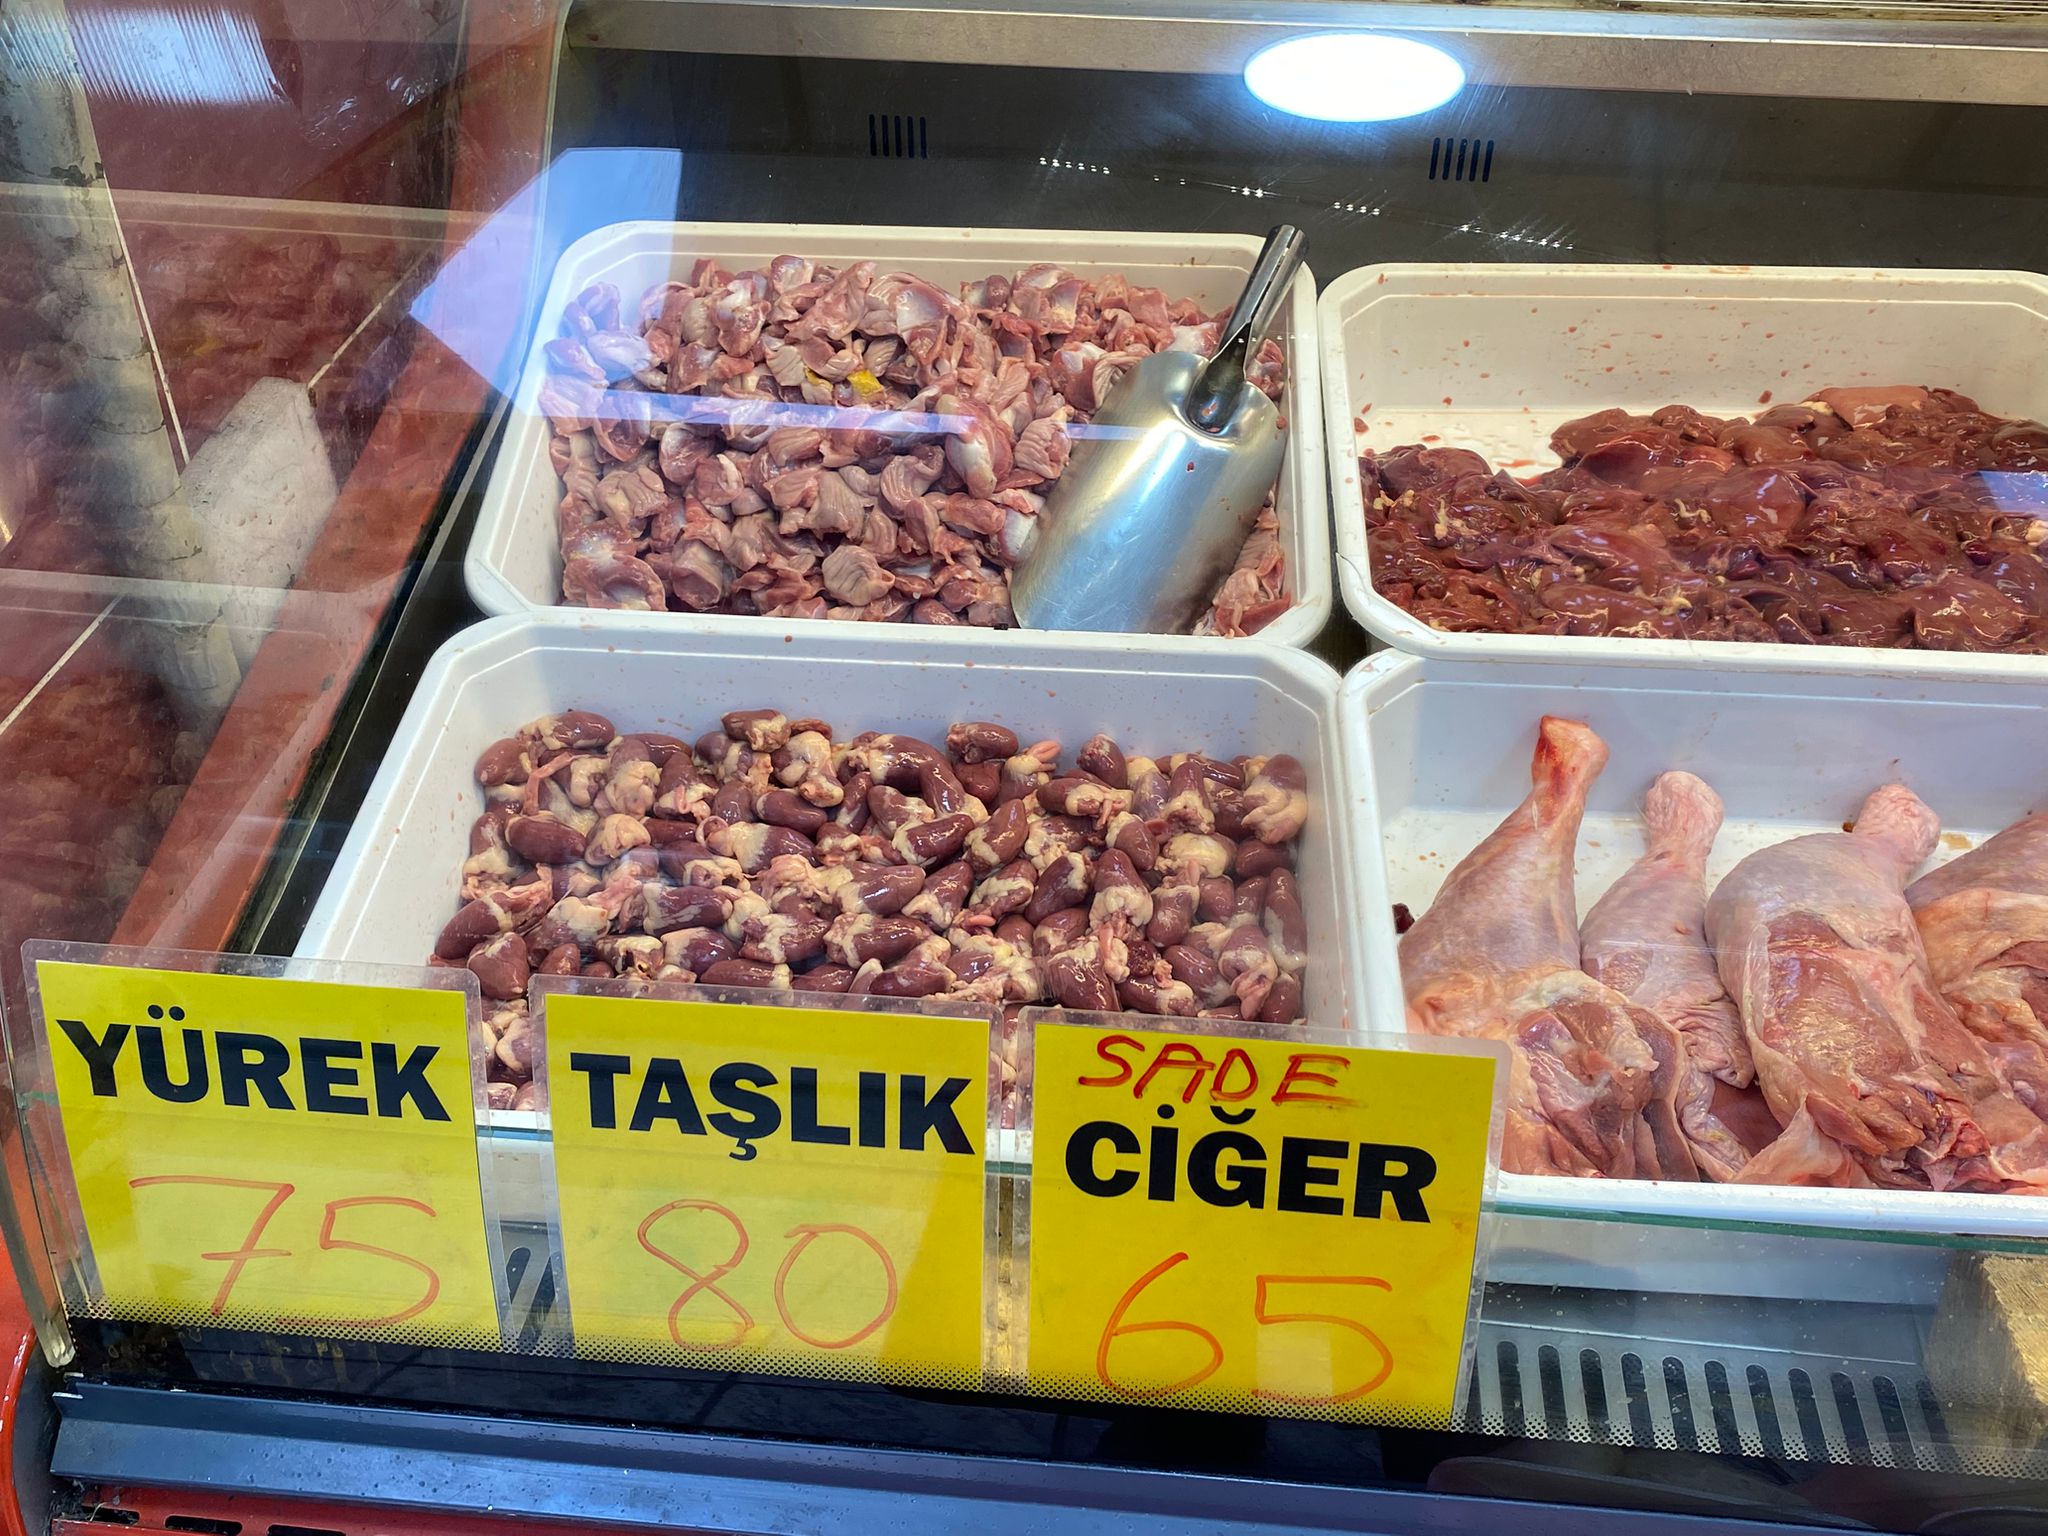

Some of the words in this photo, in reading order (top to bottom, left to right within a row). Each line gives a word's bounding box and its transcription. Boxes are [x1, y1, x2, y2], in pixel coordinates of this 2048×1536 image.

[56, 1004, 453, 1123] YÜREK
[570, 1052, 975, 1161] TAŞLIK
[1078, 1034, 1356, 1108] SADE
[1065, 1104, 1438, 1223] CİĞER
[129, 1174, 439, 1329] 75
[637, 1199, 898, 1350] 80
[1096, 1252, 1393, 1406] 65
